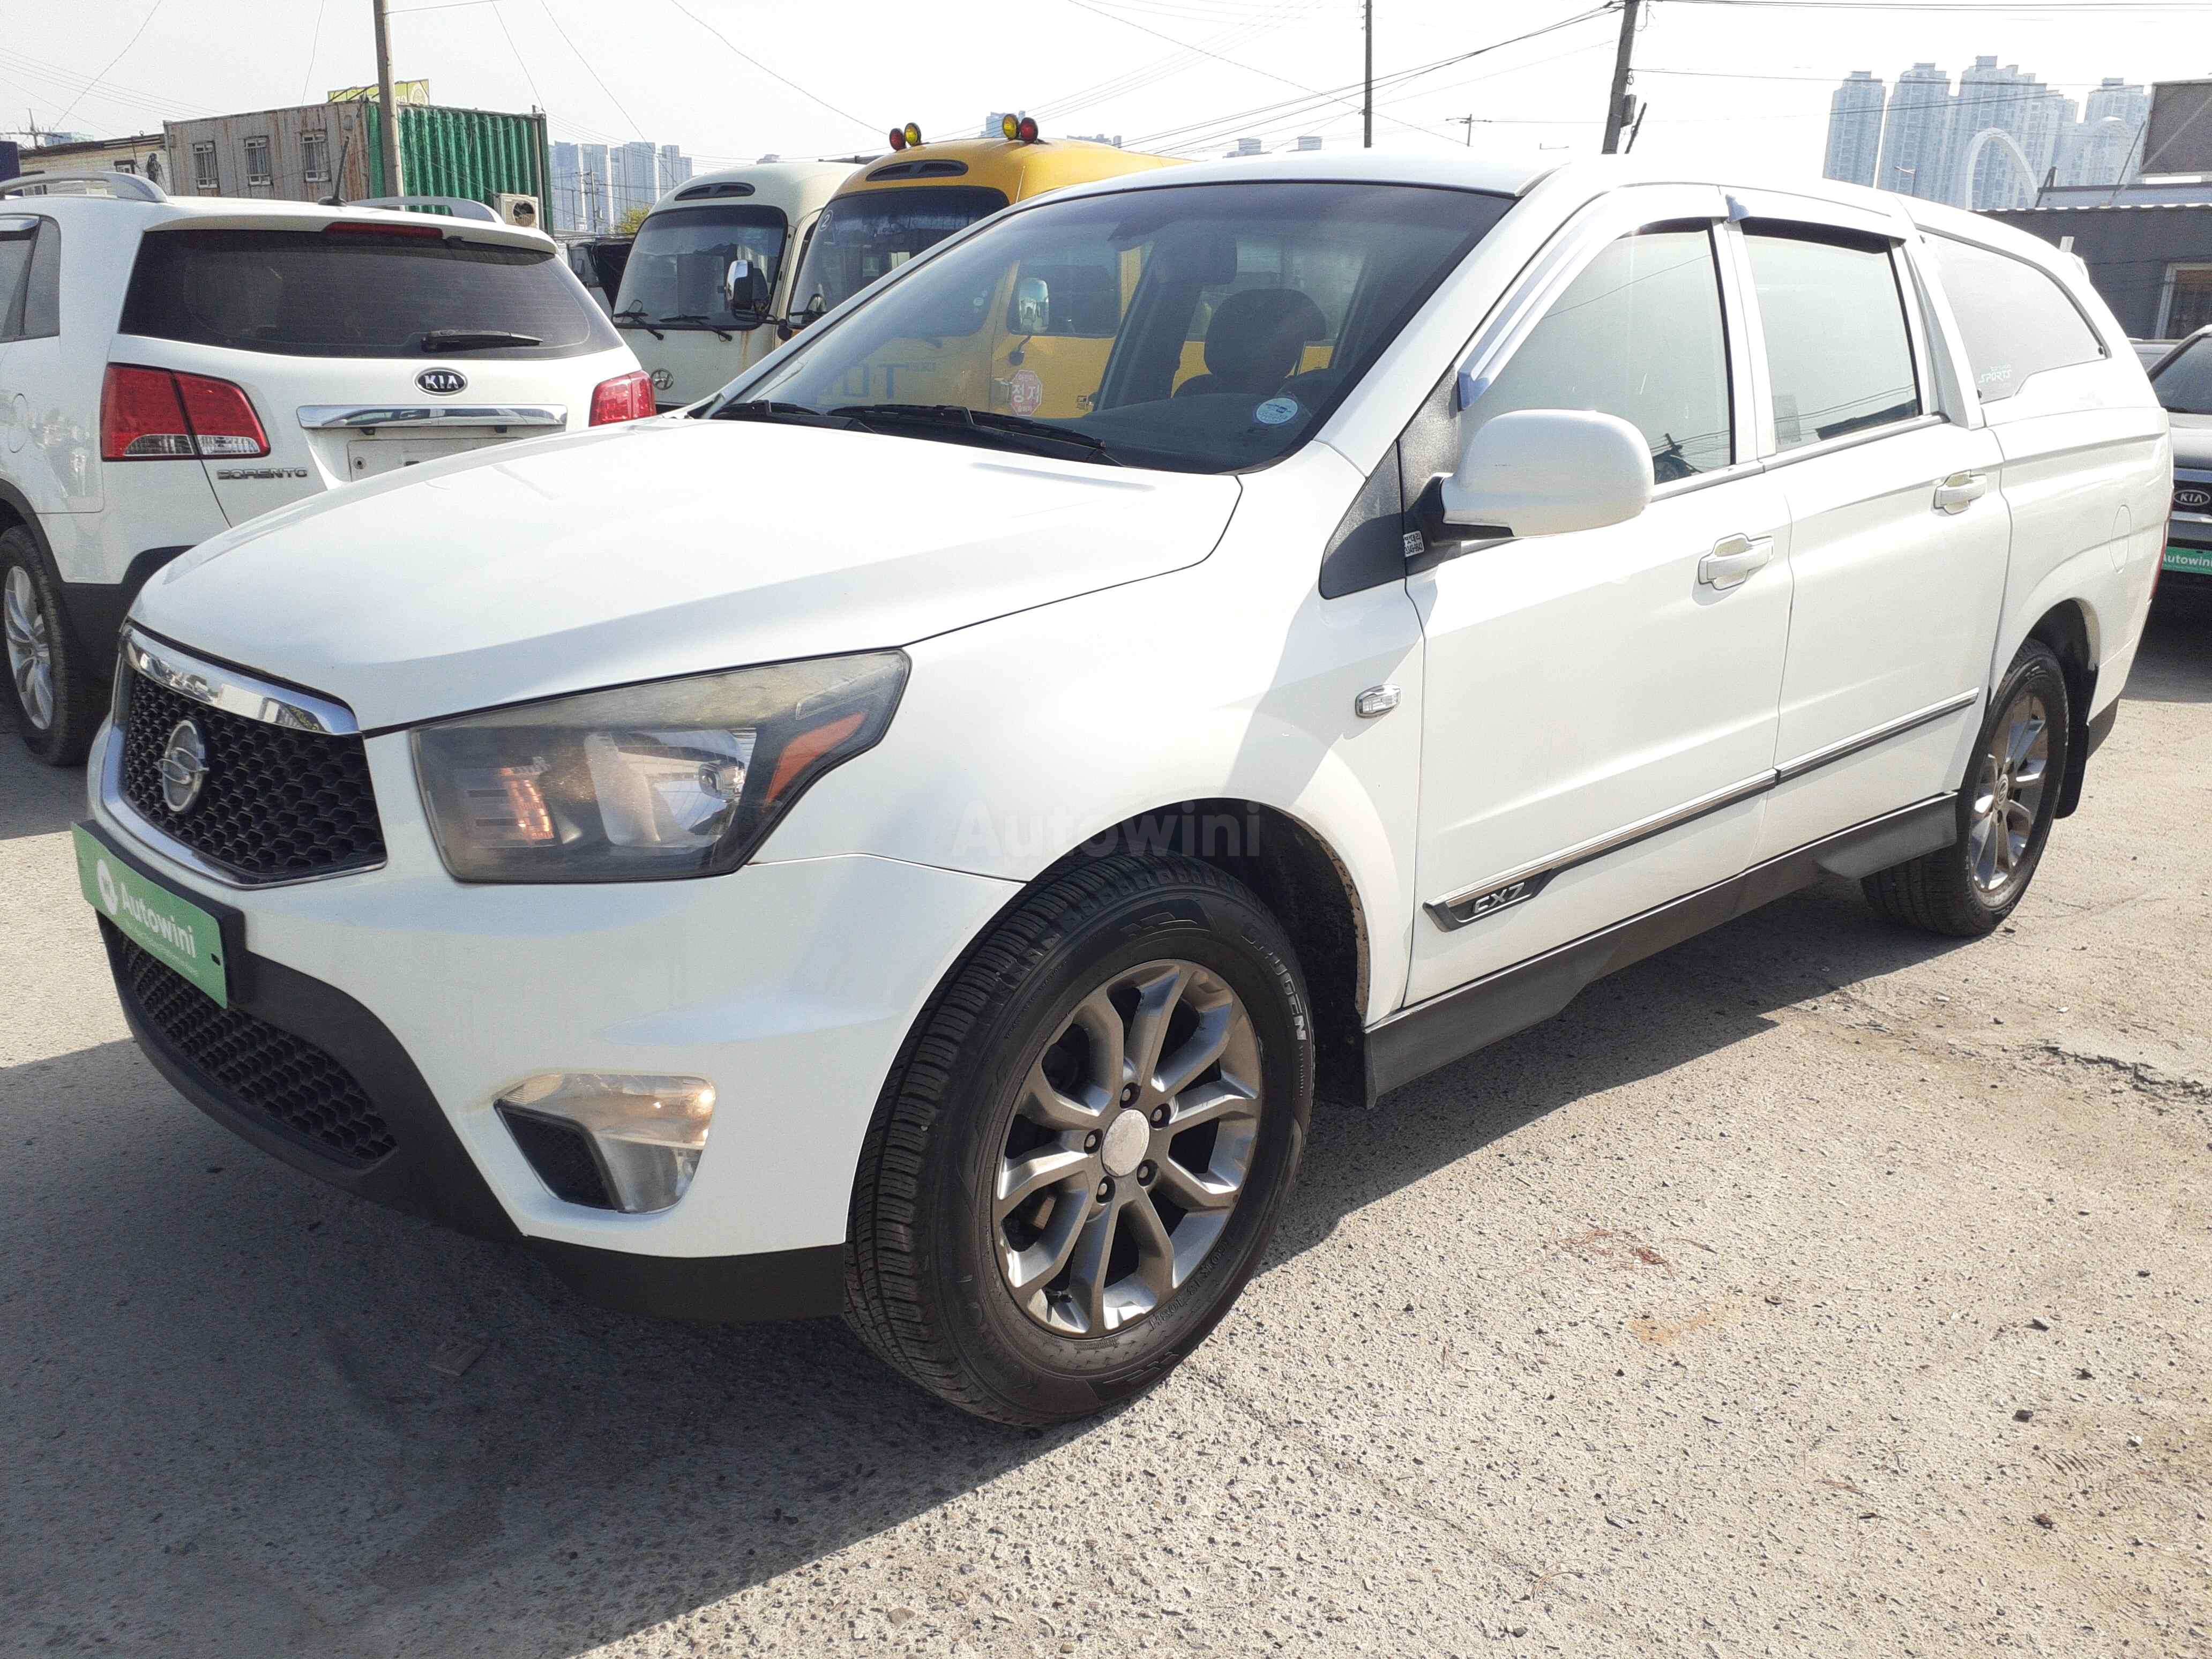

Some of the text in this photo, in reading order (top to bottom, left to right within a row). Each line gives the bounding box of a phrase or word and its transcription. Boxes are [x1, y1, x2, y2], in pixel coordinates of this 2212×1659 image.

[424, 375, 459, 390] KIA
[1978, 369, 2013, 383] SPORTS
[1012, 384, 1040, 403] 정지
[217, 468, 308, 480] SORENTO
[2180, 492, 2202, 502] KIA
[1475, 882, 1525, 913] CX7
[121, 883, 196, 958] Autowini
